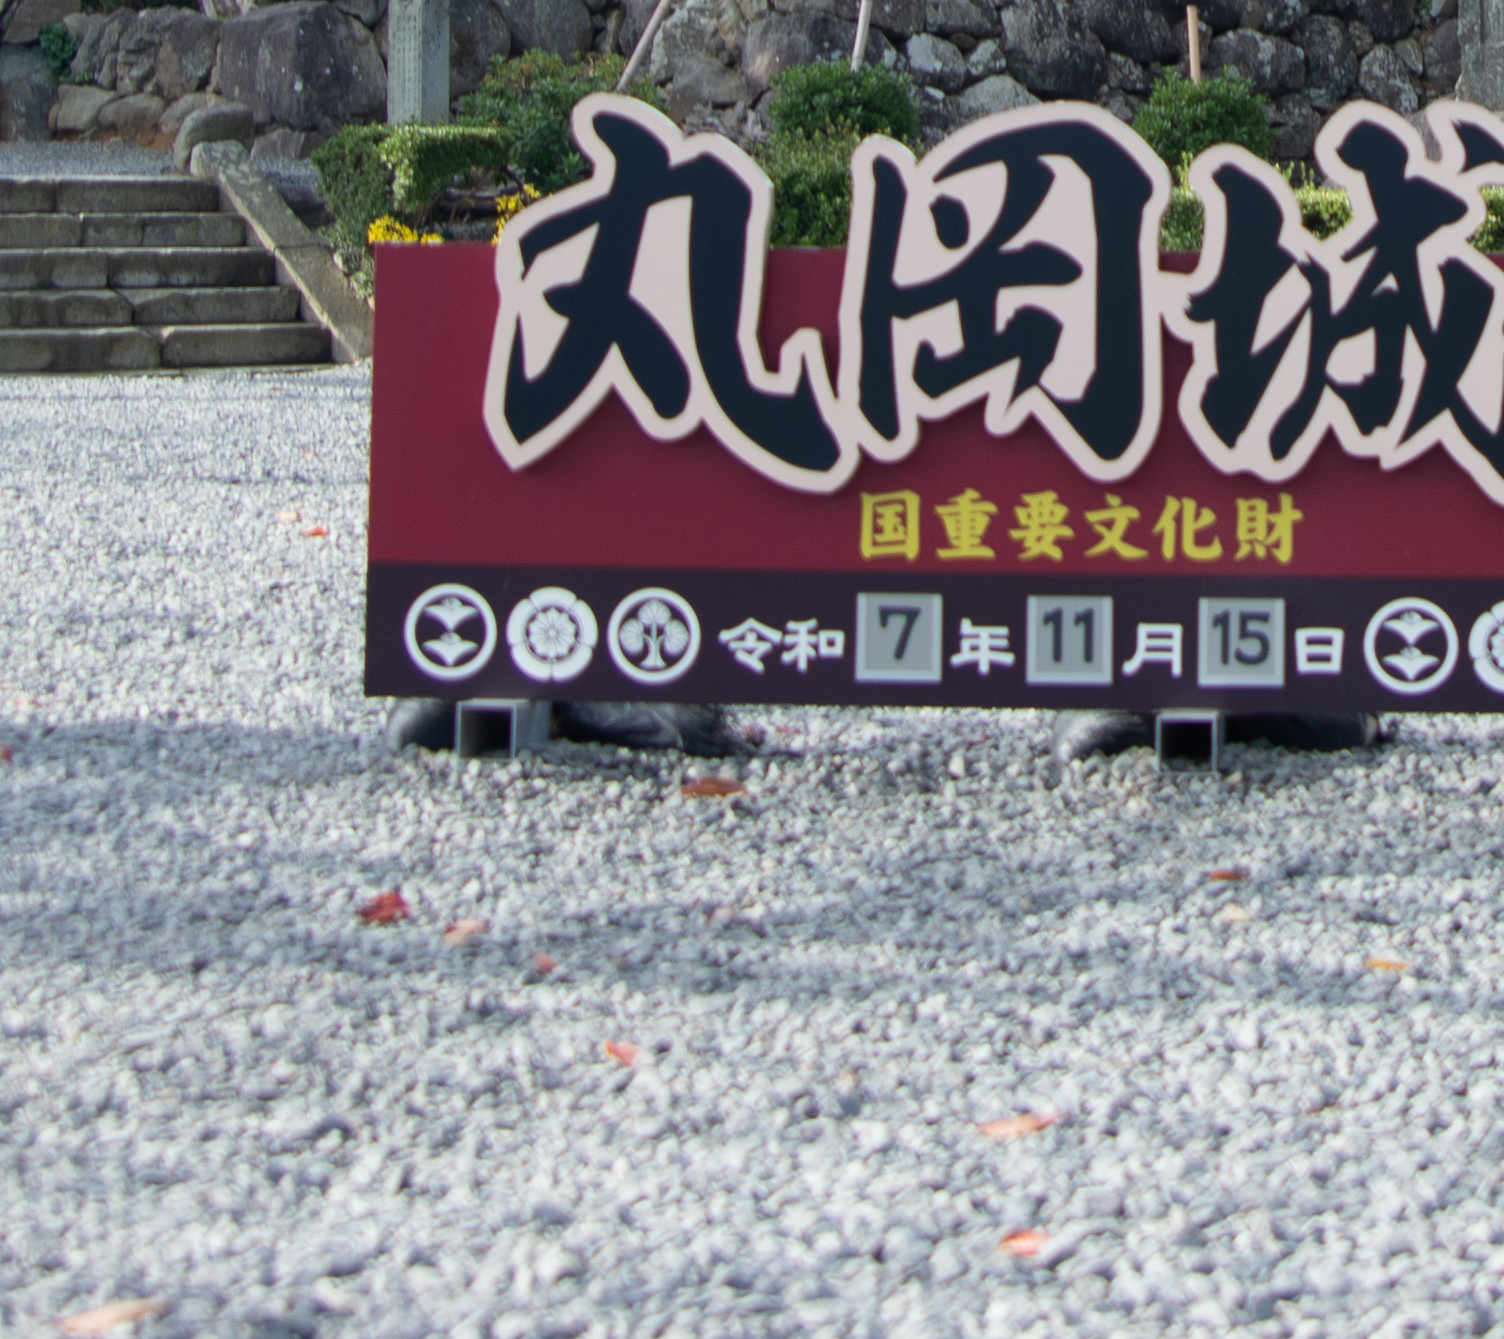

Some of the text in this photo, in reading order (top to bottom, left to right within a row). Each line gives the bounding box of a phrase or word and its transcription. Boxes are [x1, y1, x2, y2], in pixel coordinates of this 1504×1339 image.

[859, 487, 1303, 565] 国重要文化財
[717, 603, 1346, 678] 令和7年11月15日
